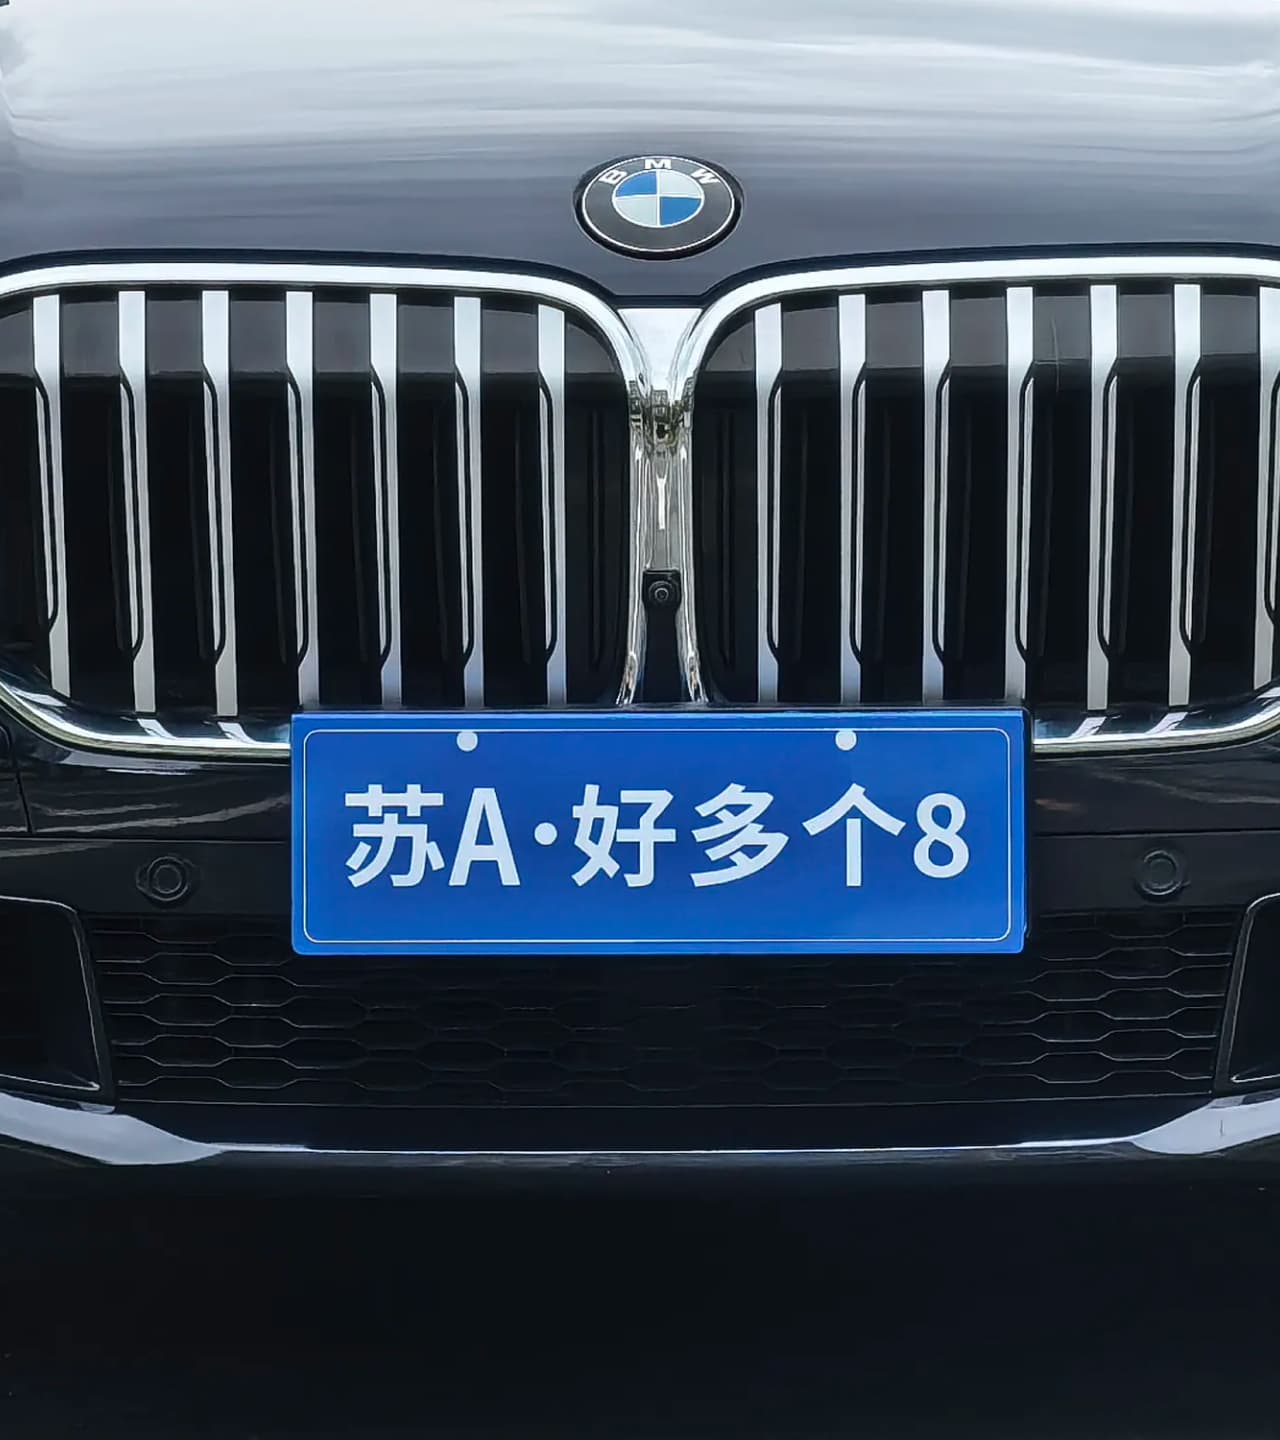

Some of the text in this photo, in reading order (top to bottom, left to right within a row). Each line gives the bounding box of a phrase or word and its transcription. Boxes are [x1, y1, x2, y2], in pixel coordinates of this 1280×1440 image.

[598, 158, 721, 186] BMW
[343, 782, 971, 889] 苏A·好多个8
